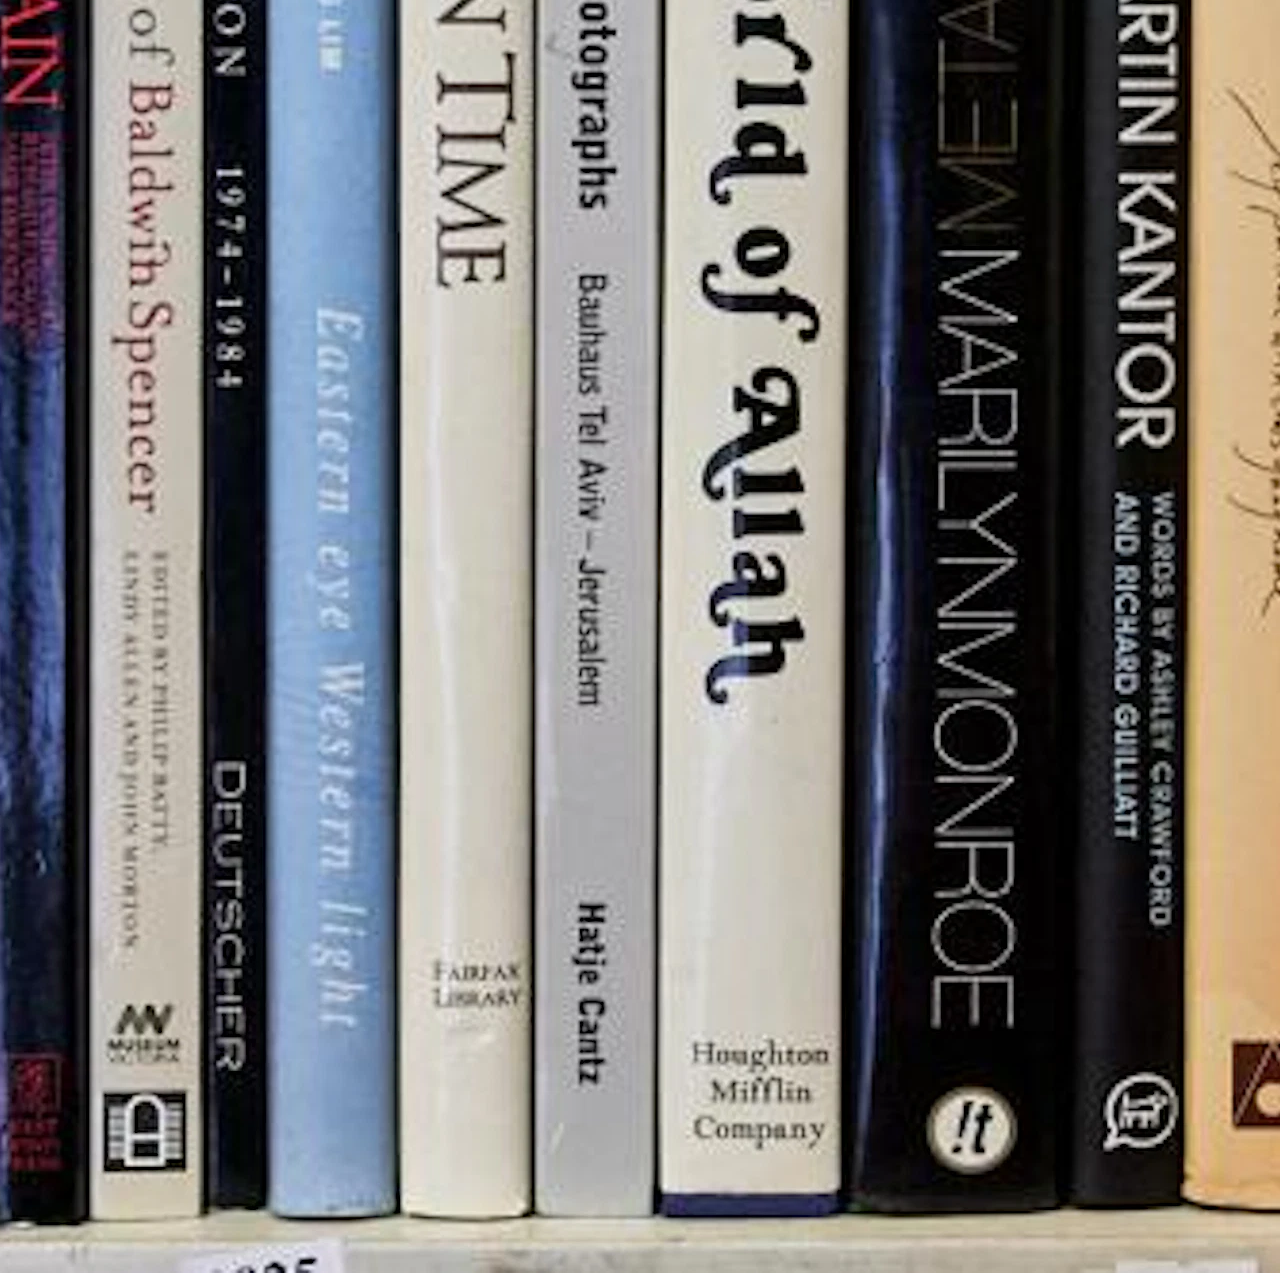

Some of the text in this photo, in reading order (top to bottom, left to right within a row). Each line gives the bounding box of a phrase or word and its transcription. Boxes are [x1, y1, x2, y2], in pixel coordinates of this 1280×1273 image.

[128, 8, 176, 67] of
[315, 19, 344, 72] LIM
[127, 81, 176, 290] Baldwin
[435, 52, 519, 292] TIME
[701, 226, 820, 343] of
[1112, 171, 1179, 450] KANTOR
[111, 300, 173, 514] Spencer
[576, 273, 608, 707] Bauhaus Tel Aviv Jerusalem
[701, 365, 806, 706] Allah
[118, 549, 140, 949] LINDY ALLEN AND JOHN MORTON
[150, 550, 170, 768] EDITED BY PHILIP
[310, 306, 368, 1029] Eastern eye Western light
[1113, 491, 1140, 840] AND RICHARD GUILLIATT
[1147, 491, 1177, 927] WORDS BY ASHLEY CRAWFORD
[211, 759, 249, 1073] DEUTSCHER
[433, 958, 521, 983] FAIRFAX
[433, 987, 521, 1010] LIBRARY
[570, 900, 609, 1085] Hatje Cantz
[691, 1038, 831, 1073] Houghton
[693, 1116, 826, 1148] Company
[710, 1076, 813, 1105] Mifflin
